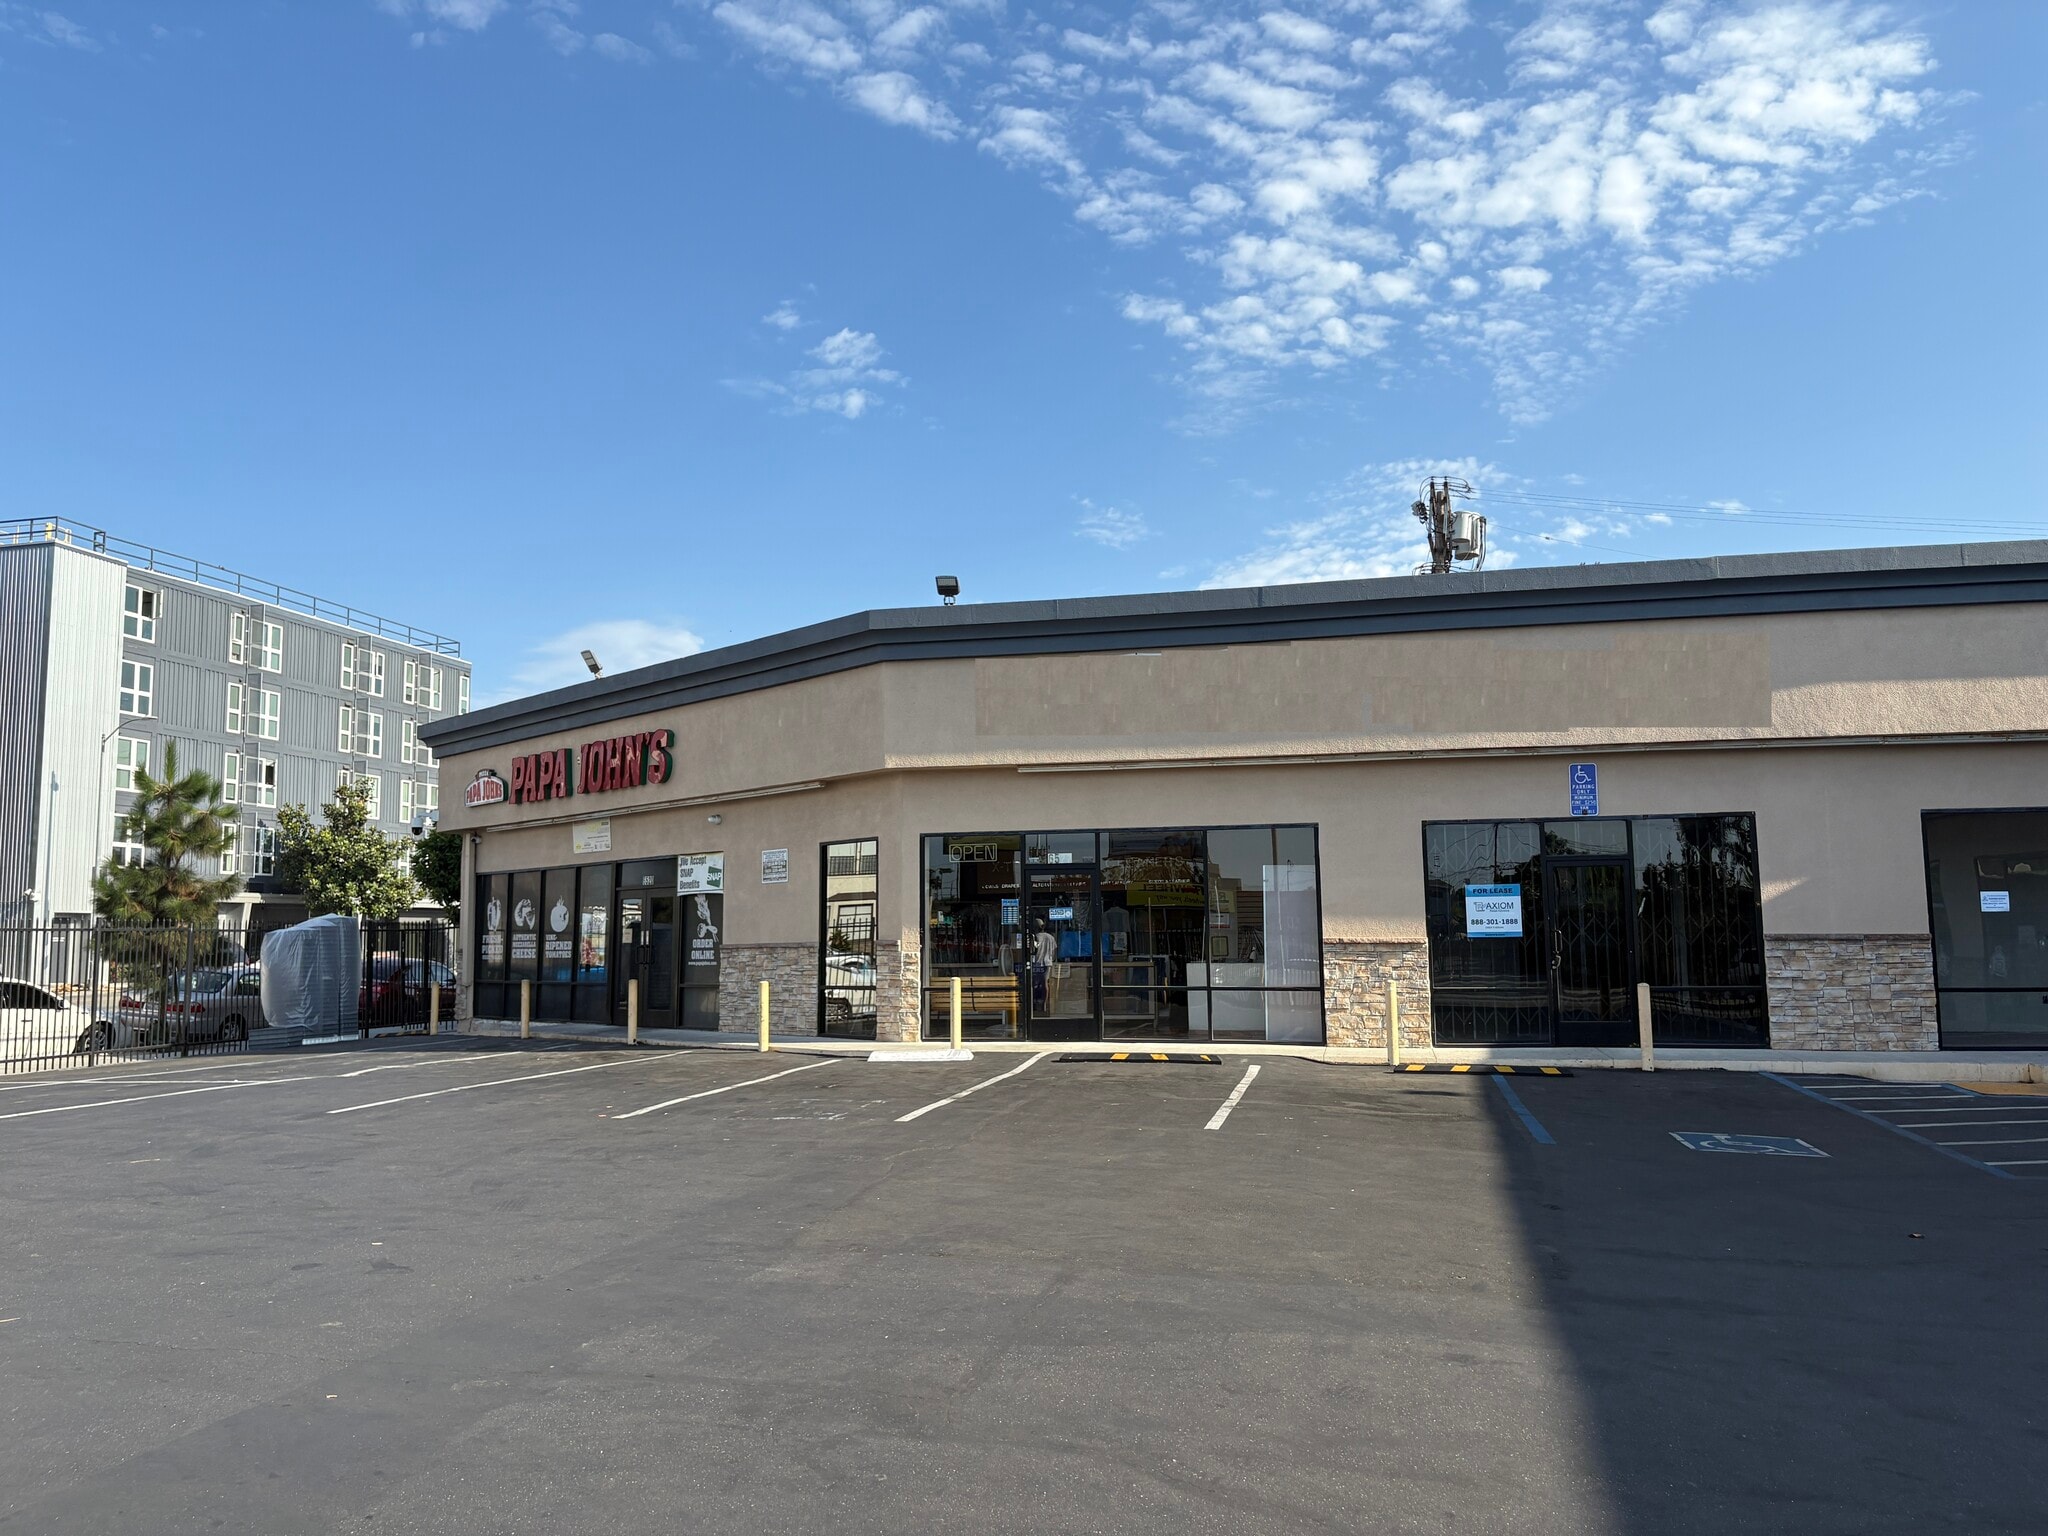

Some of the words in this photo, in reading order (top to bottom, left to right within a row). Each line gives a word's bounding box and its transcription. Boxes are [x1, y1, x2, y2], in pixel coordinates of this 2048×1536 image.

[509, 748, 573, 805] PAPA
[577, 729, 675, 794] JOHN'S
[466, 781, 482, 803] PAPA
[951, 844, 997, 861] OPEN
[689, 855, 707, 867] Accept
[679, 868, 694, 878] SNAP
[706, 872, 722, 881] SNAP
[679, 879, 700, 890] Benefits
[1485, 901, 1514, 910] AXIOM
[1470, 918, 1519, 926] 888-301-1888
[545, 941, 573, 950] RIPENED
[692, 938, 714, 948] ORDER
[512, 948, 537, 958] CHEESE
[545, 950, 572, 958] TOMATOES
[691, 950, 715, 960] ONLINE
